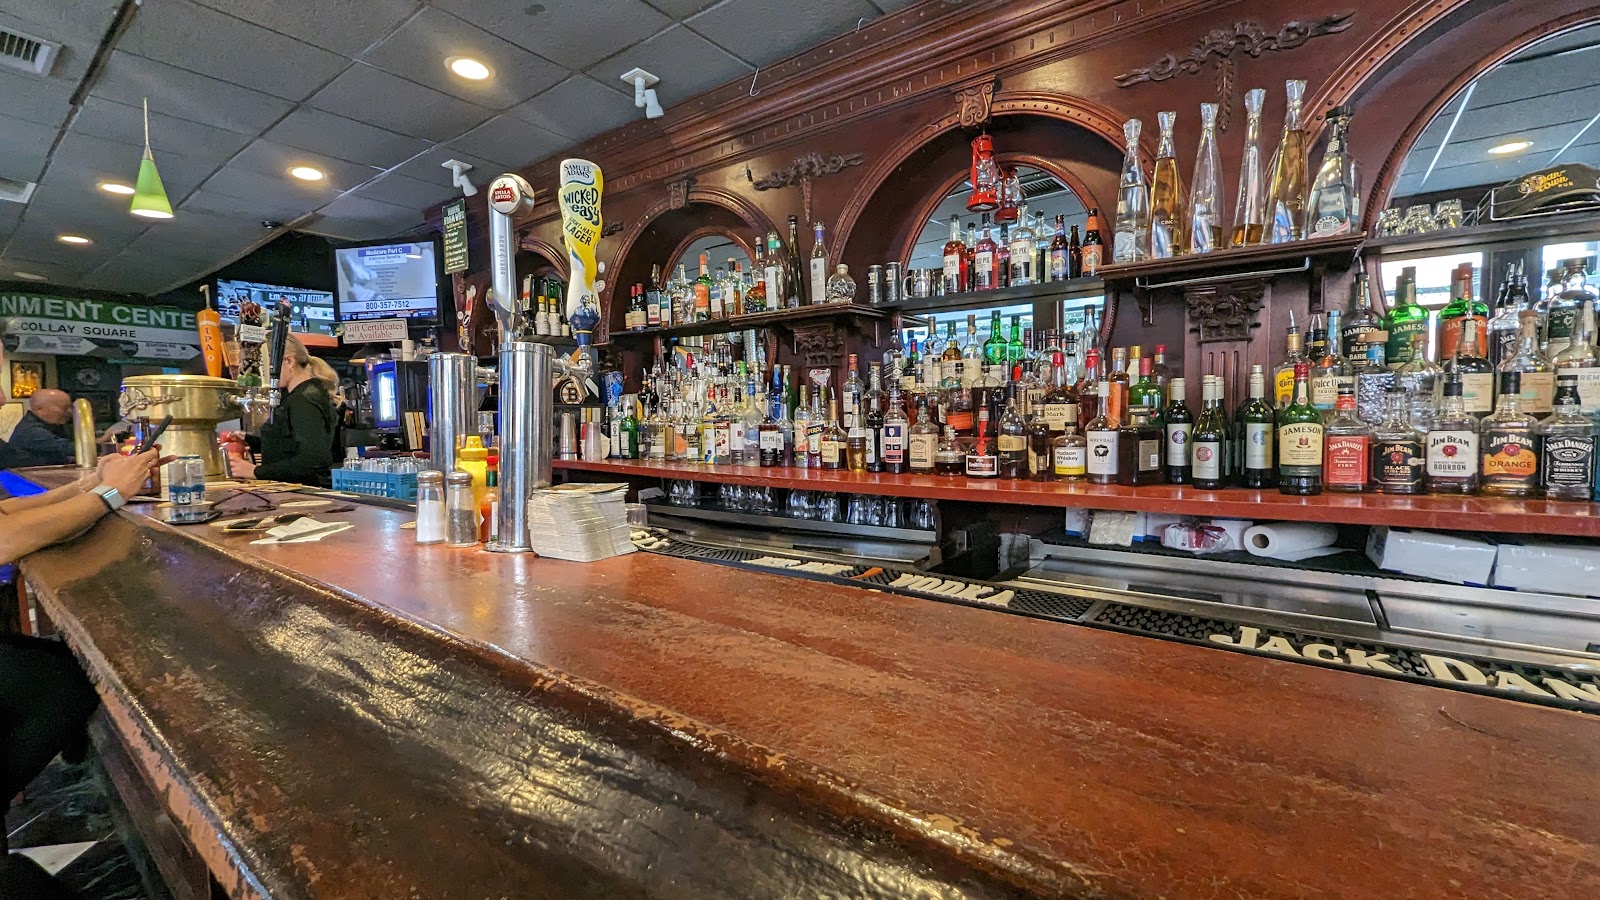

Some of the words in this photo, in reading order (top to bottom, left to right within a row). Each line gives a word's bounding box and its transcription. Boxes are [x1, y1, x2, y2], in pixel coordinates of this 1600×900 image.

[564, 164, 590, 173] SAMUEL
[566, 169, 591, 179] ADAMS
[569, 204, 600, 227] easy
[565, 222, 592, 246] LAGER
[365, 300, 410, 310] 800-357-7512
[112, 306, 197, 328] CENTE
[13, 322, 76, 334] SCOLLAY
[83, 326, 137, 338] SQUARE
[345, 323, 360, 333] Gift
[361, 322, 404, 333] Certificates
[1392, 323, 1427, 335] JAMESO
[204, 327, 215, 351] IPA
[358, 331, 393, 340] Available
[1283, 426, 1321, 436] JAMESON
[1328, 442, 1342, 451] JACK
[1341, 440, 1363, 451] DANIEL'S
[1430, 438, 1446, 448] JIM
[1446, 435, 1470, 448] BEAM
[1489, 435, 1508, 448] JIM
[1508, 434, 1533, 448] BEAM
[1545, 440, 1564, 452] JACK
[1564, 439, 1594, 453] DANIEL'S
[1382, 446, 1395, 456] JIM
[1395, 444, 1413, 456] BEAM
[1489, 460, 1532, 469] ORANGE
[1209, 625, 1402, 674] JACK
